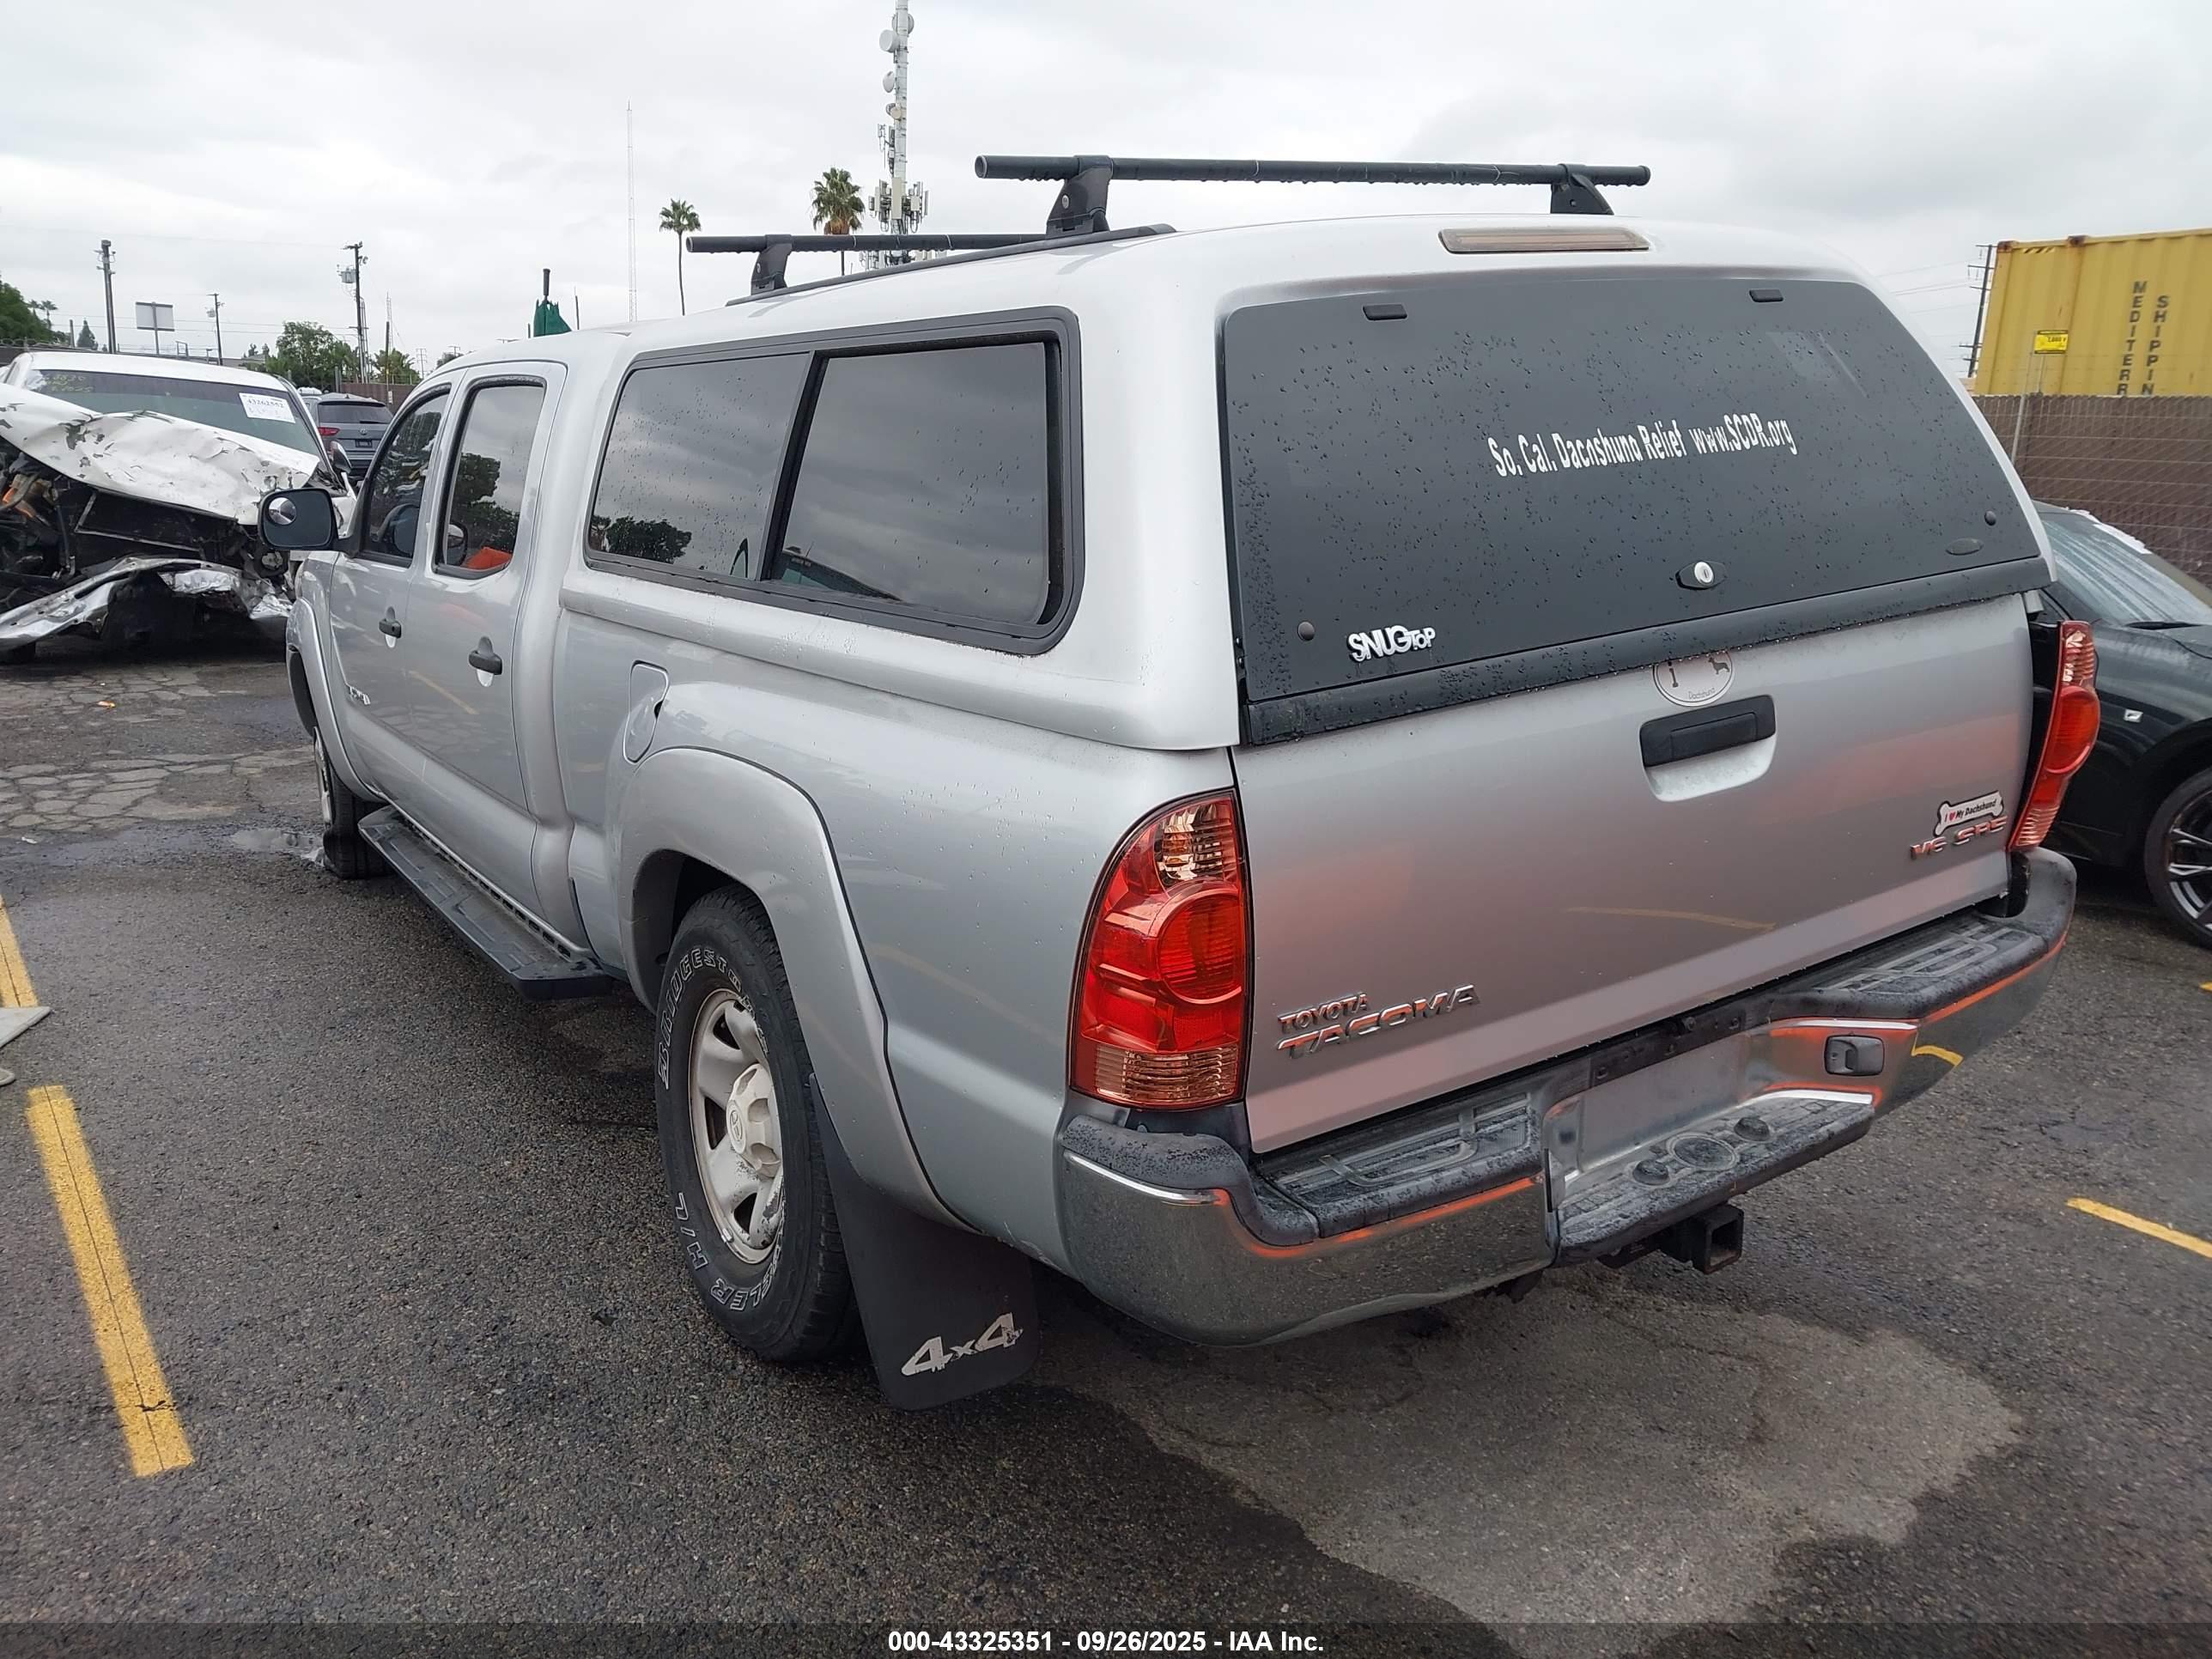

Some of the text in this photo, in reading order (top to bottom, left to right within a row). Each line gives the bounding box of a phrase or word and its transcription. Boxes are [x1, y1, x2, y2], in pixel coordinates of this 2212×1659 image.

[1637, 419, 1687, 459] Relief
[1688, 413, 1798, 455] www.SCDR.org
[1276, 984, 1481, 1060] TACOMA
[1277, 992, 1372, 1033] TOYOTA
